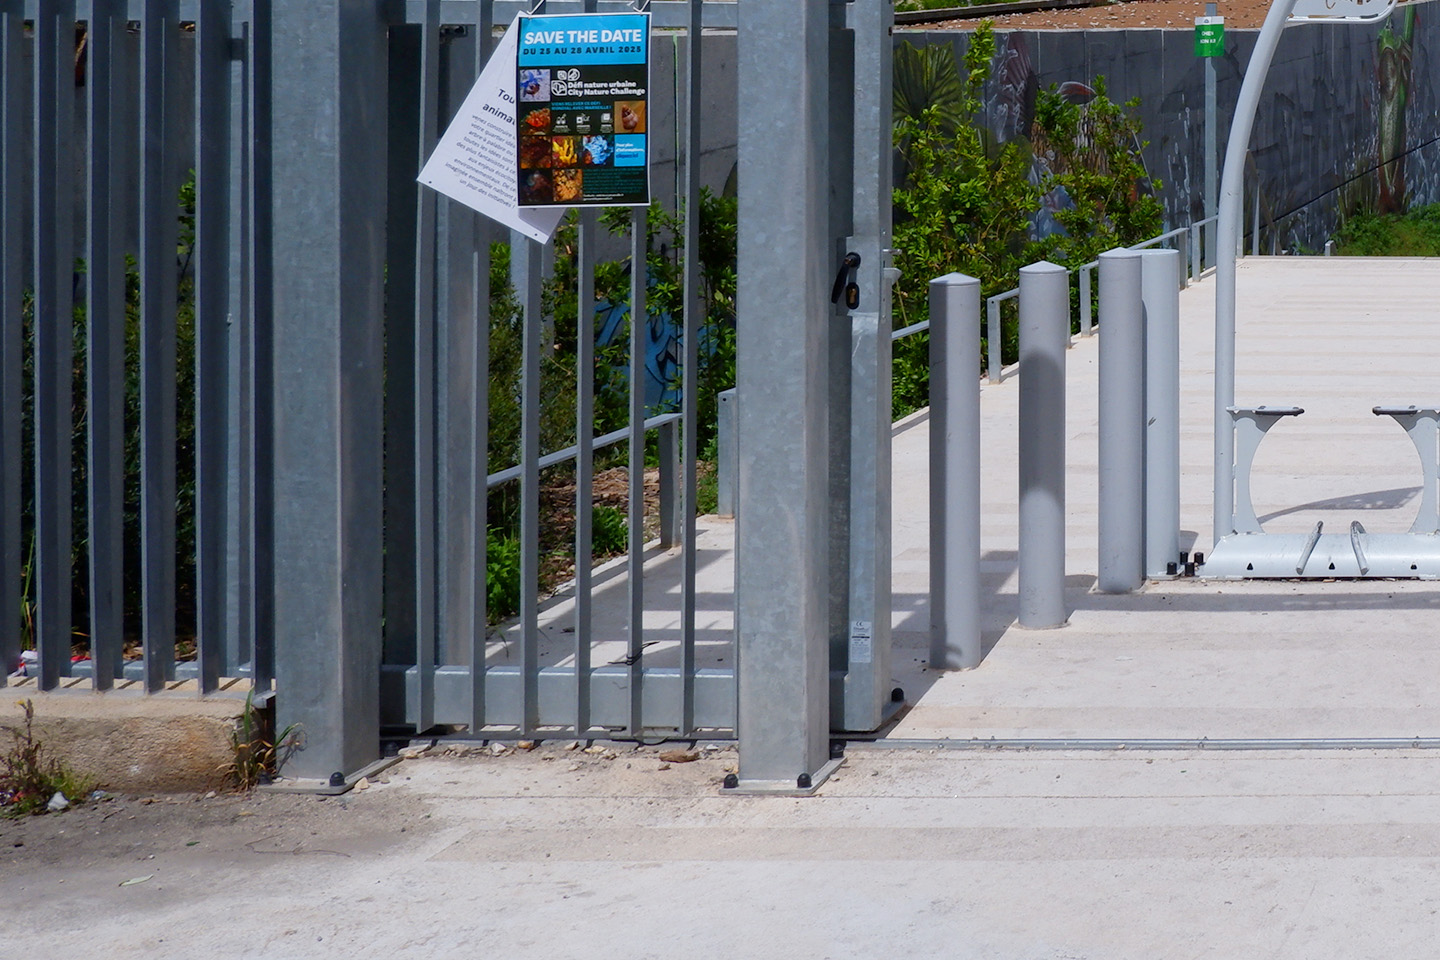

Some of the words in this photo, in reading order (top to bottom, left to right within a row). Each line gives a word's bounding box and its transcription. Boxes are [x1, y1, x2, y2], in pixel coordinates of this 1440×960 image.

[524, 31, 564, 45] SAVE
[567, 30, 598, 44] THE
[601, 29, 642, 43] DATE
[539, 47, 551, 55] 25
[585, 46, 614, 54] AVRIL
[568, 81, 583, 89] Défi
[567, 88, 583, 97] City
[610, 87, 645, 96] Challenge
